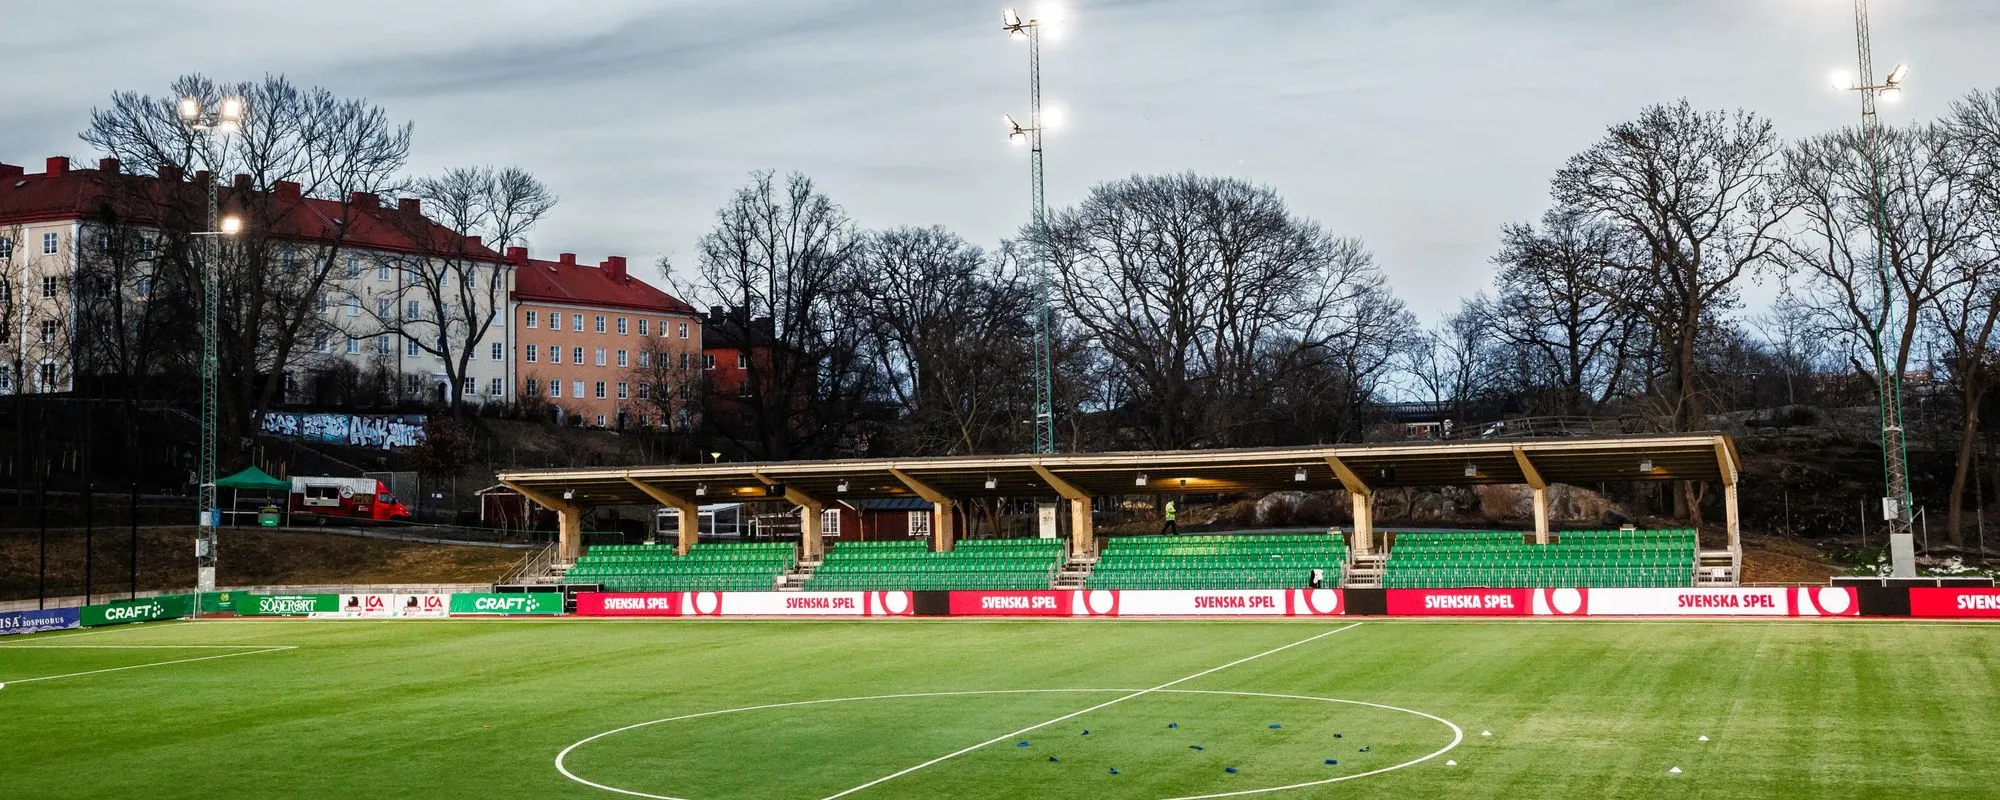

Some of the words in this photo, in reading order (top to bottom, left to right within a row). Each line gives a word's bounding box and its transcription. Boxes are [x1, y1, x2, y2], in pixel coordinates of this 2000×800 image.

[365, 595, 384, 608] ICA
[424, 595, 443, 608] ICA
[475, 597, 526, 610] CRAFT
[604, 598, 643, 610] SVENSKA
[645, 598, 669, 610] SPEL
[786, 598, 830, 609] SVENSKA
[833, 598, 855, 609] SPEL
[982, 597, 1030, 609] SVENSKA
[1032, 597, 1057, 609] SPEL
[1195, 596, 1246, 609] SVENSKA
[1249, 596, 1276, 609] SPEL
[1425, 595, 1482, 608] SVENSKA
[1485, 595, 1515, 608] SPEL
[1678, 595, 1740, 608] SVENSKA
[1743, 595, 1776, 608] SPEL
[105, 604, 152, 620] CRAFT
